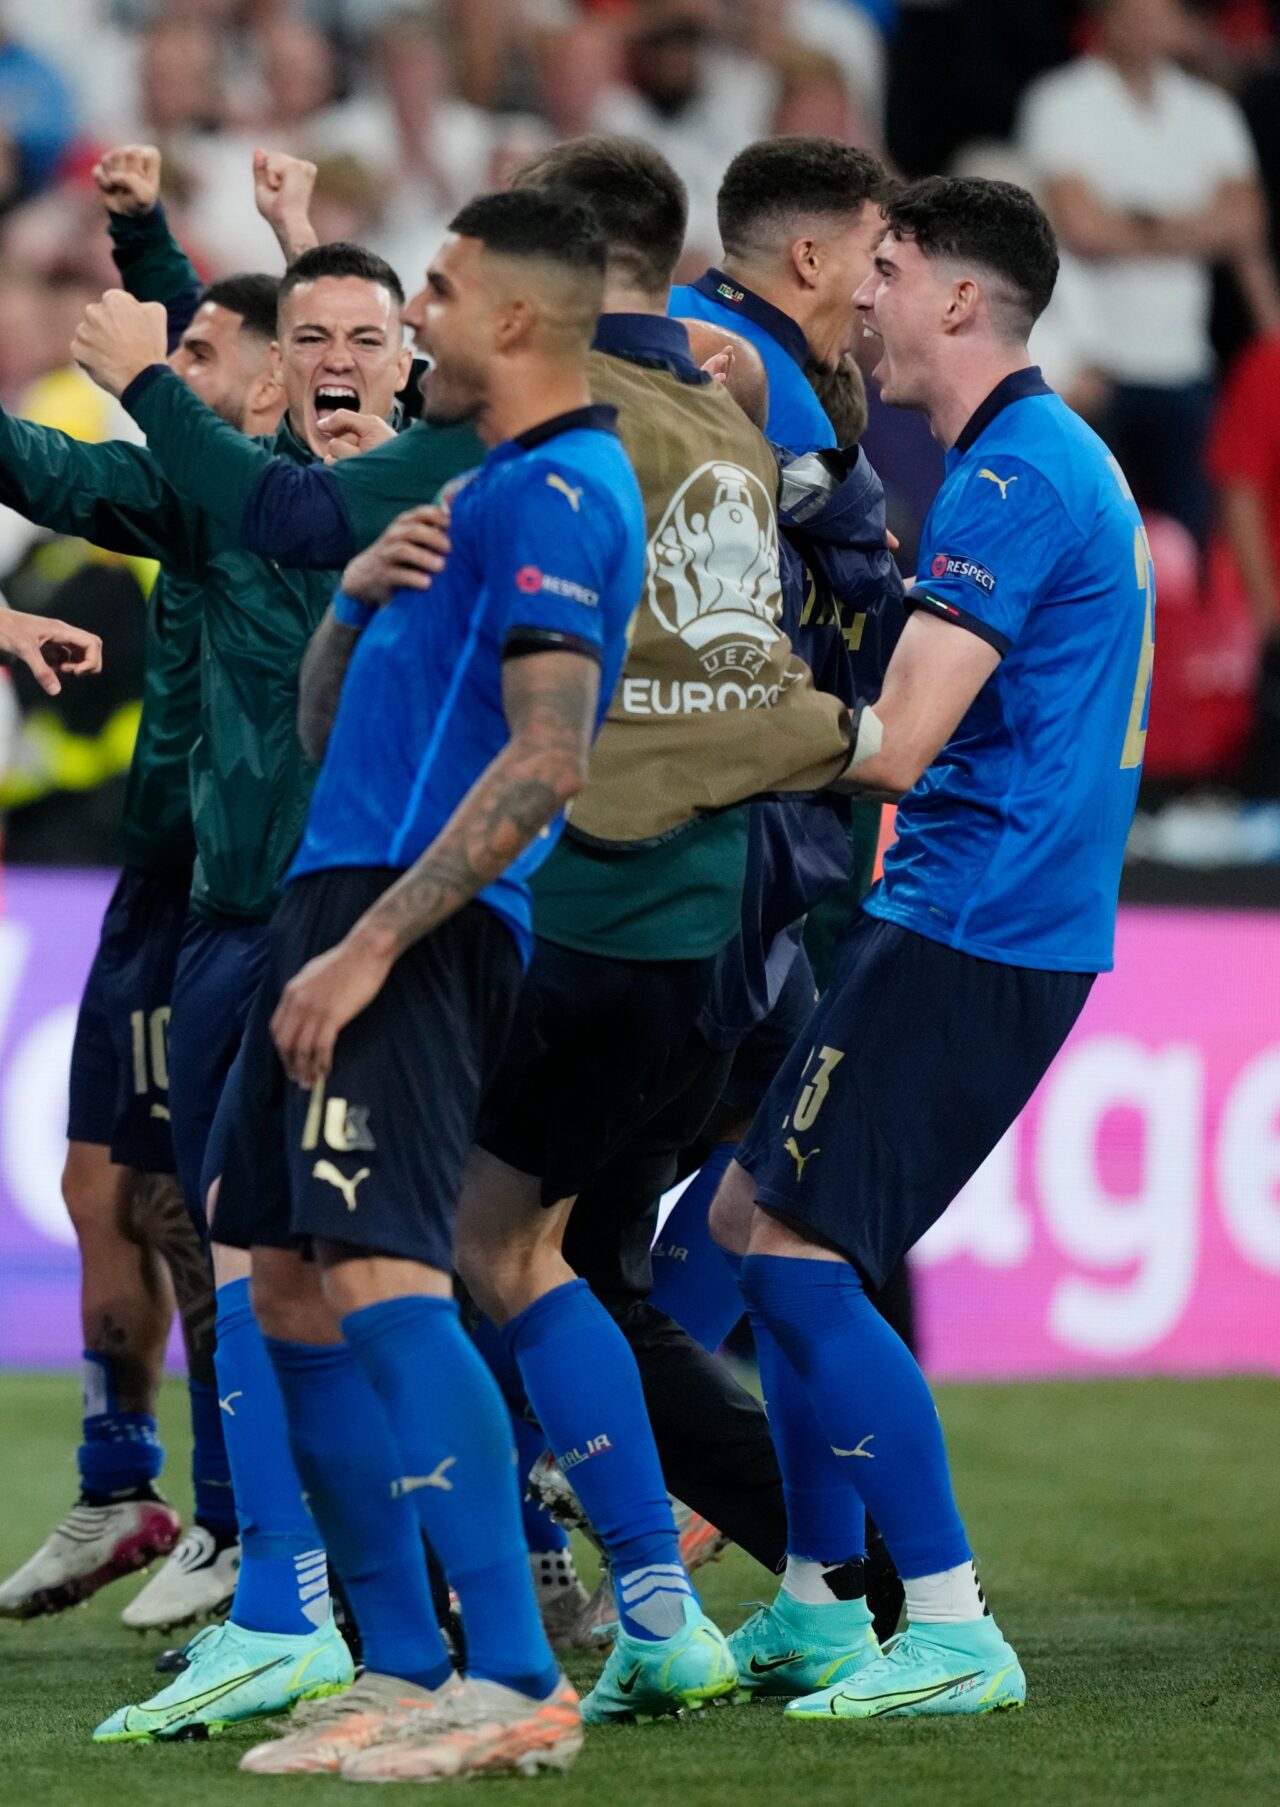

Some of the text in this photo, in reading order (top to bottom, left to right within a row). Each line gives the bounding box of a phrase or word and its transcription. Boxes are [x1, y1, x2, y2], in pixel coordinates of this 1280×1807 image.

[946, 559, 996, 591] RESPECT
[703, 649, 765, 677] UEFA
[130, 1006, 172, 1094] 10
[782, 1045, 845, 1131] 3
